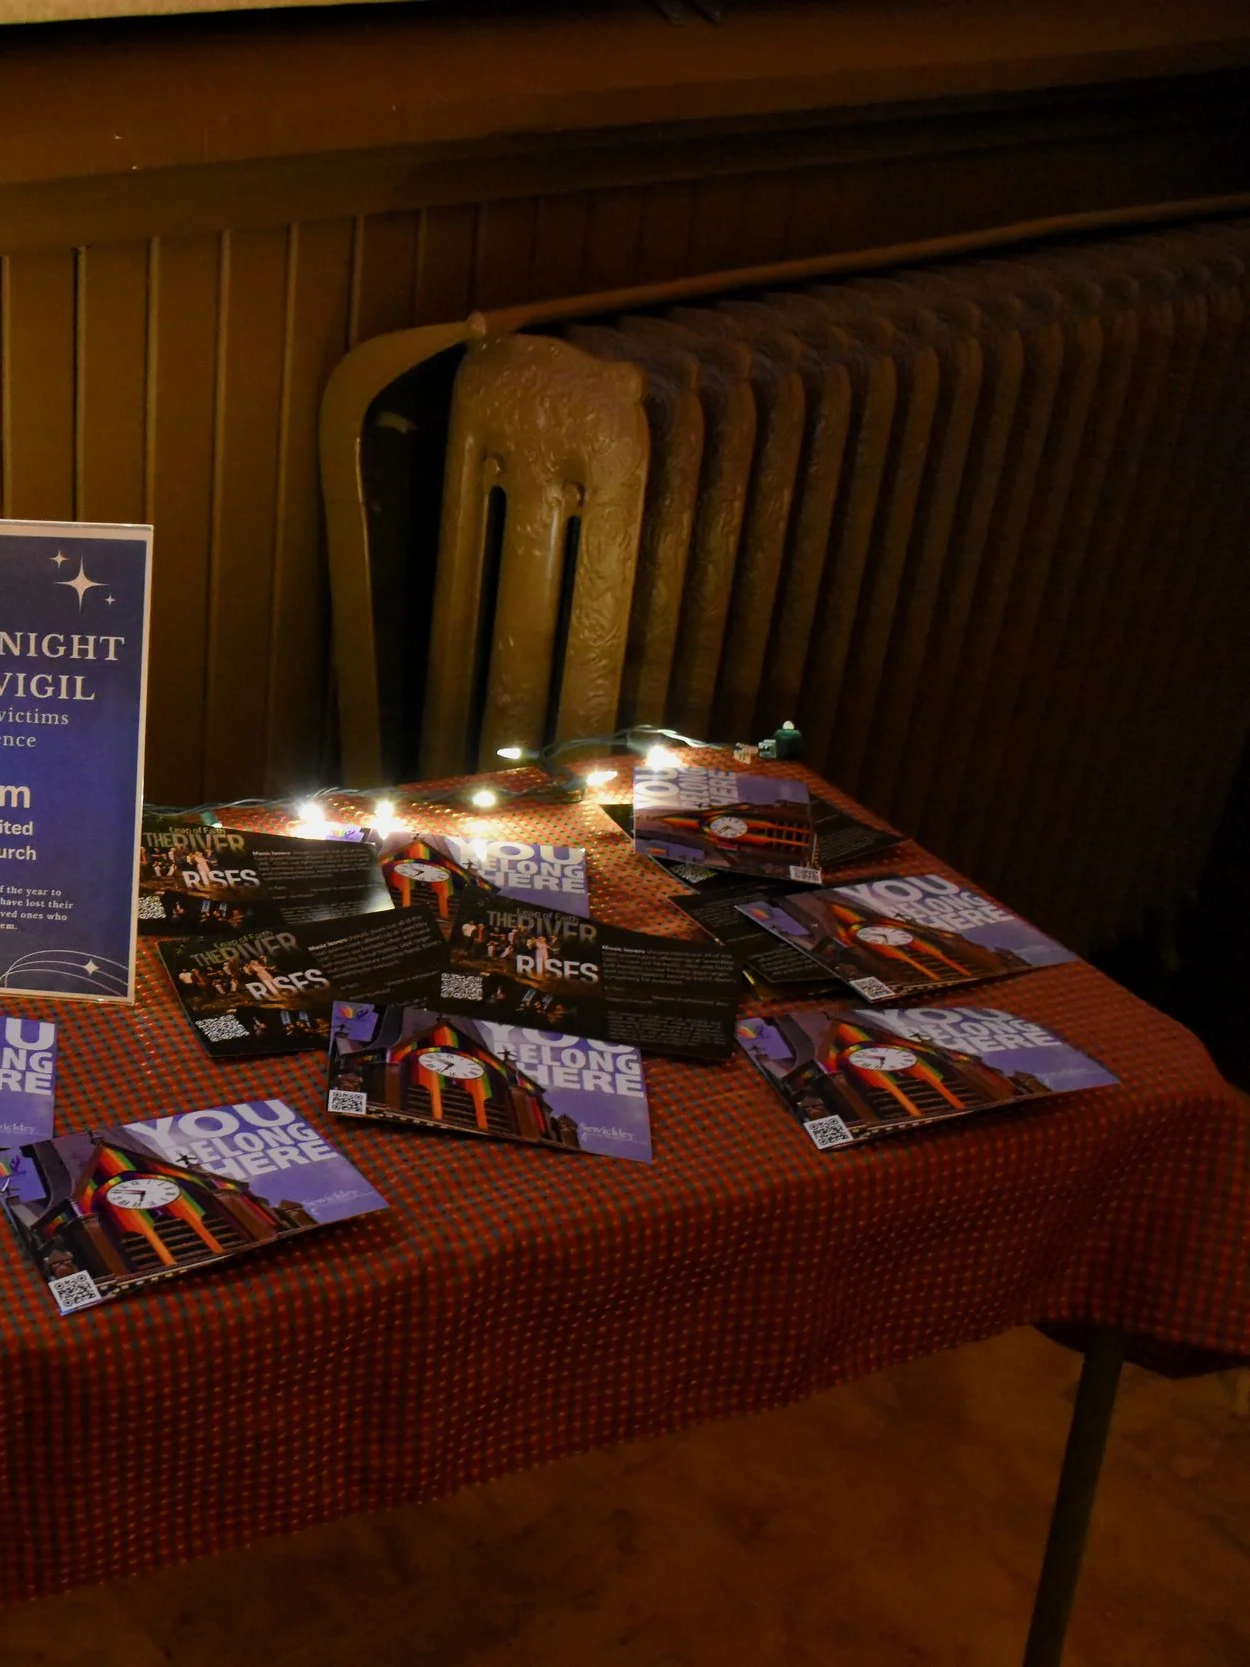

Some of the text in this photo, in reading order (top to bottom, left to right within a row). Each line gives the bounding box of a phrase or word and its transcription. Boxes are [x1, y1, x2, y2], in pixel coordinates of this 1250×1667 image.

[181, 869, 261, 891] RISES
[461, 856, 585, 879] ELONG
[0, 897, 23, 906] have
[26, 898, 45, 908] lost
[48, 900, 74, 910] their
[6, 886, 23, 895] the
[26, 888, 48, 896] year
[51, 889, 62, 897] to
[832, 874, 960, 912] YOU
[20, 911, 44, 919] ones
[46, 912, 68, 921] who
[516, 954, 599, 984] RISES
[245, 968, 330, 1001] RISES
[854, 1007, 1014, 1034] YOU
[516, 1062, 644, 1098] HERE
[122, 1099, 297, 1150] YOU
[166, 1122, 320, 1168] BELONG
[200, 1139, 340, 1180] HERE
